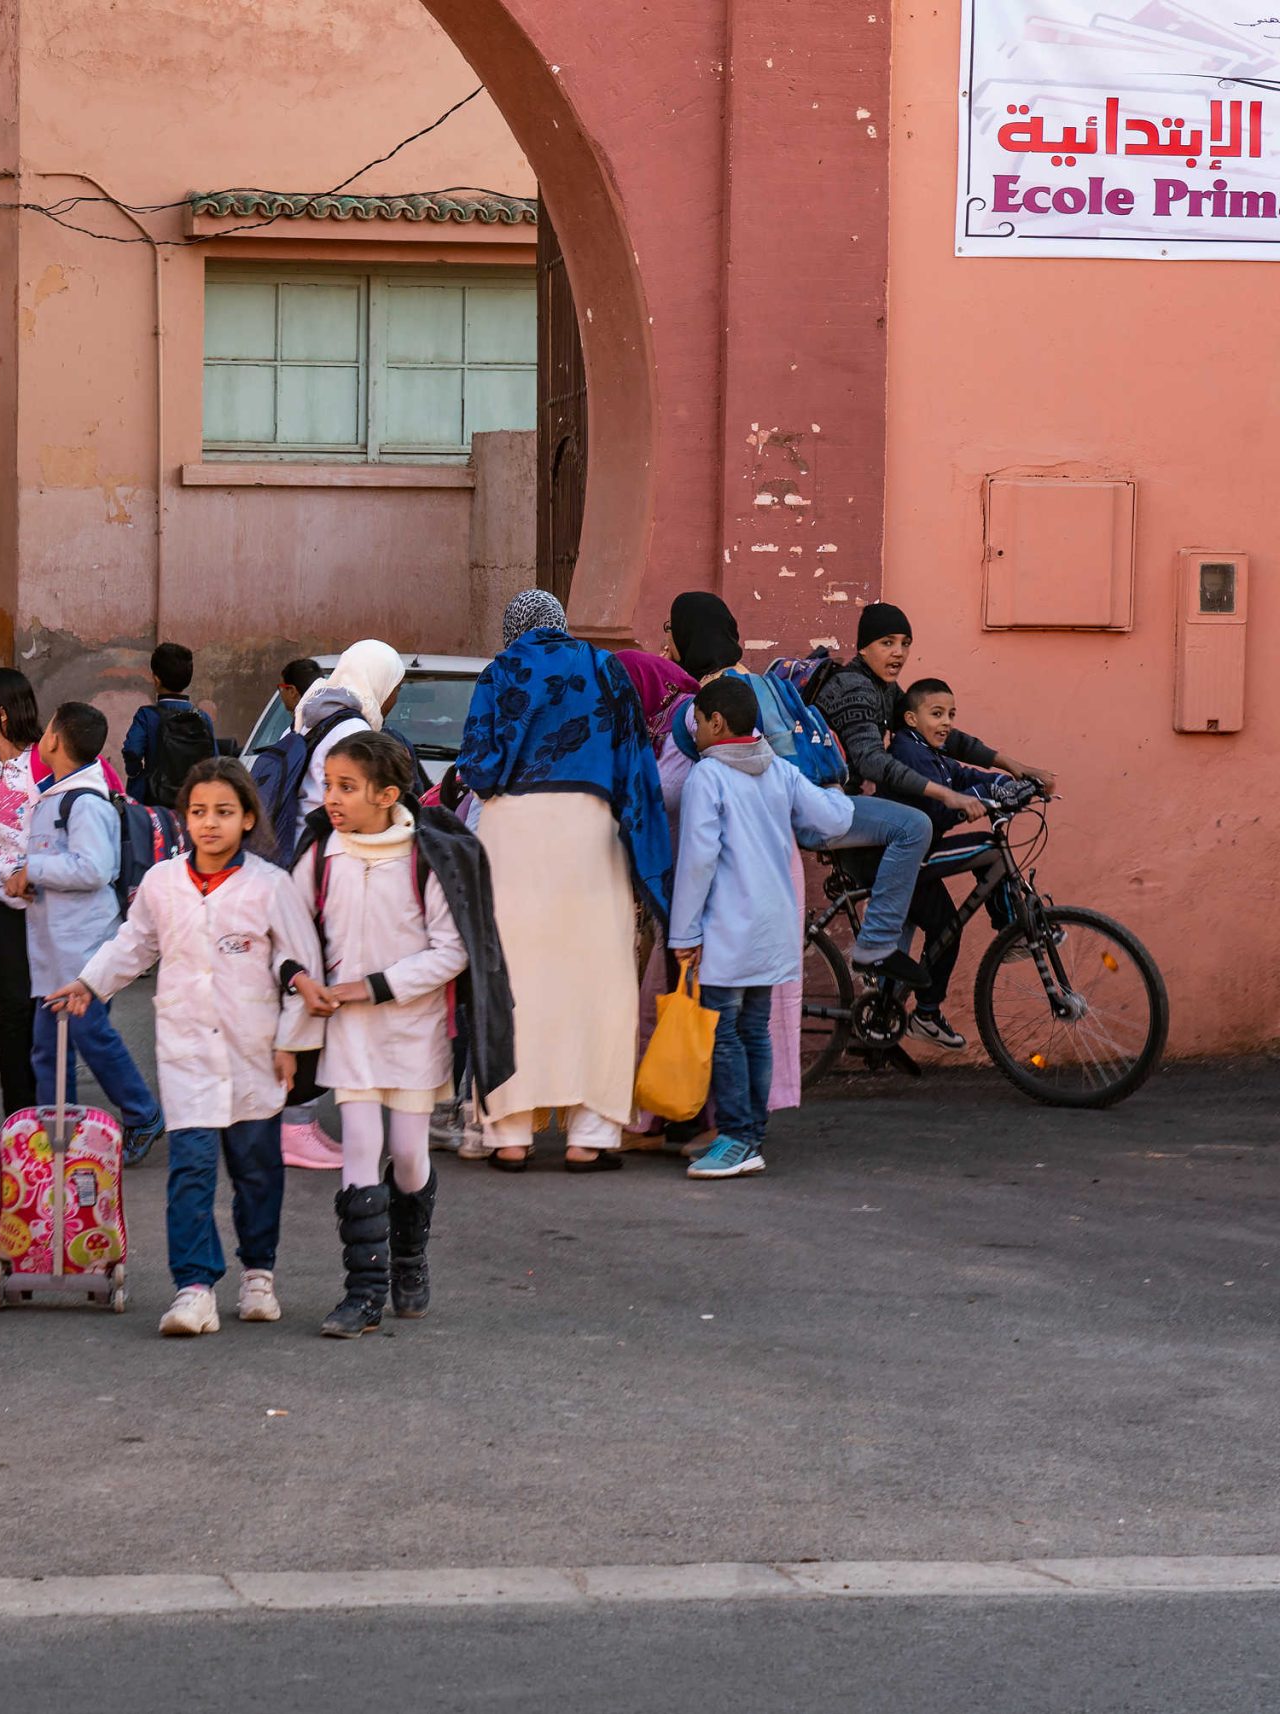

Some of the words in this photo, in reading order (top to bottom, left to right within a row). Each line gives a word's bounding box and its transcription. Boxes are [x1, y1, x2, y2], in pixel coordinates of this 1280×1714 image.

[997, 97, 1262, 170] الإبتدائية
[991, 174, 1135, 216] Ecole
[1153, 178, 1280, 218] Prim
